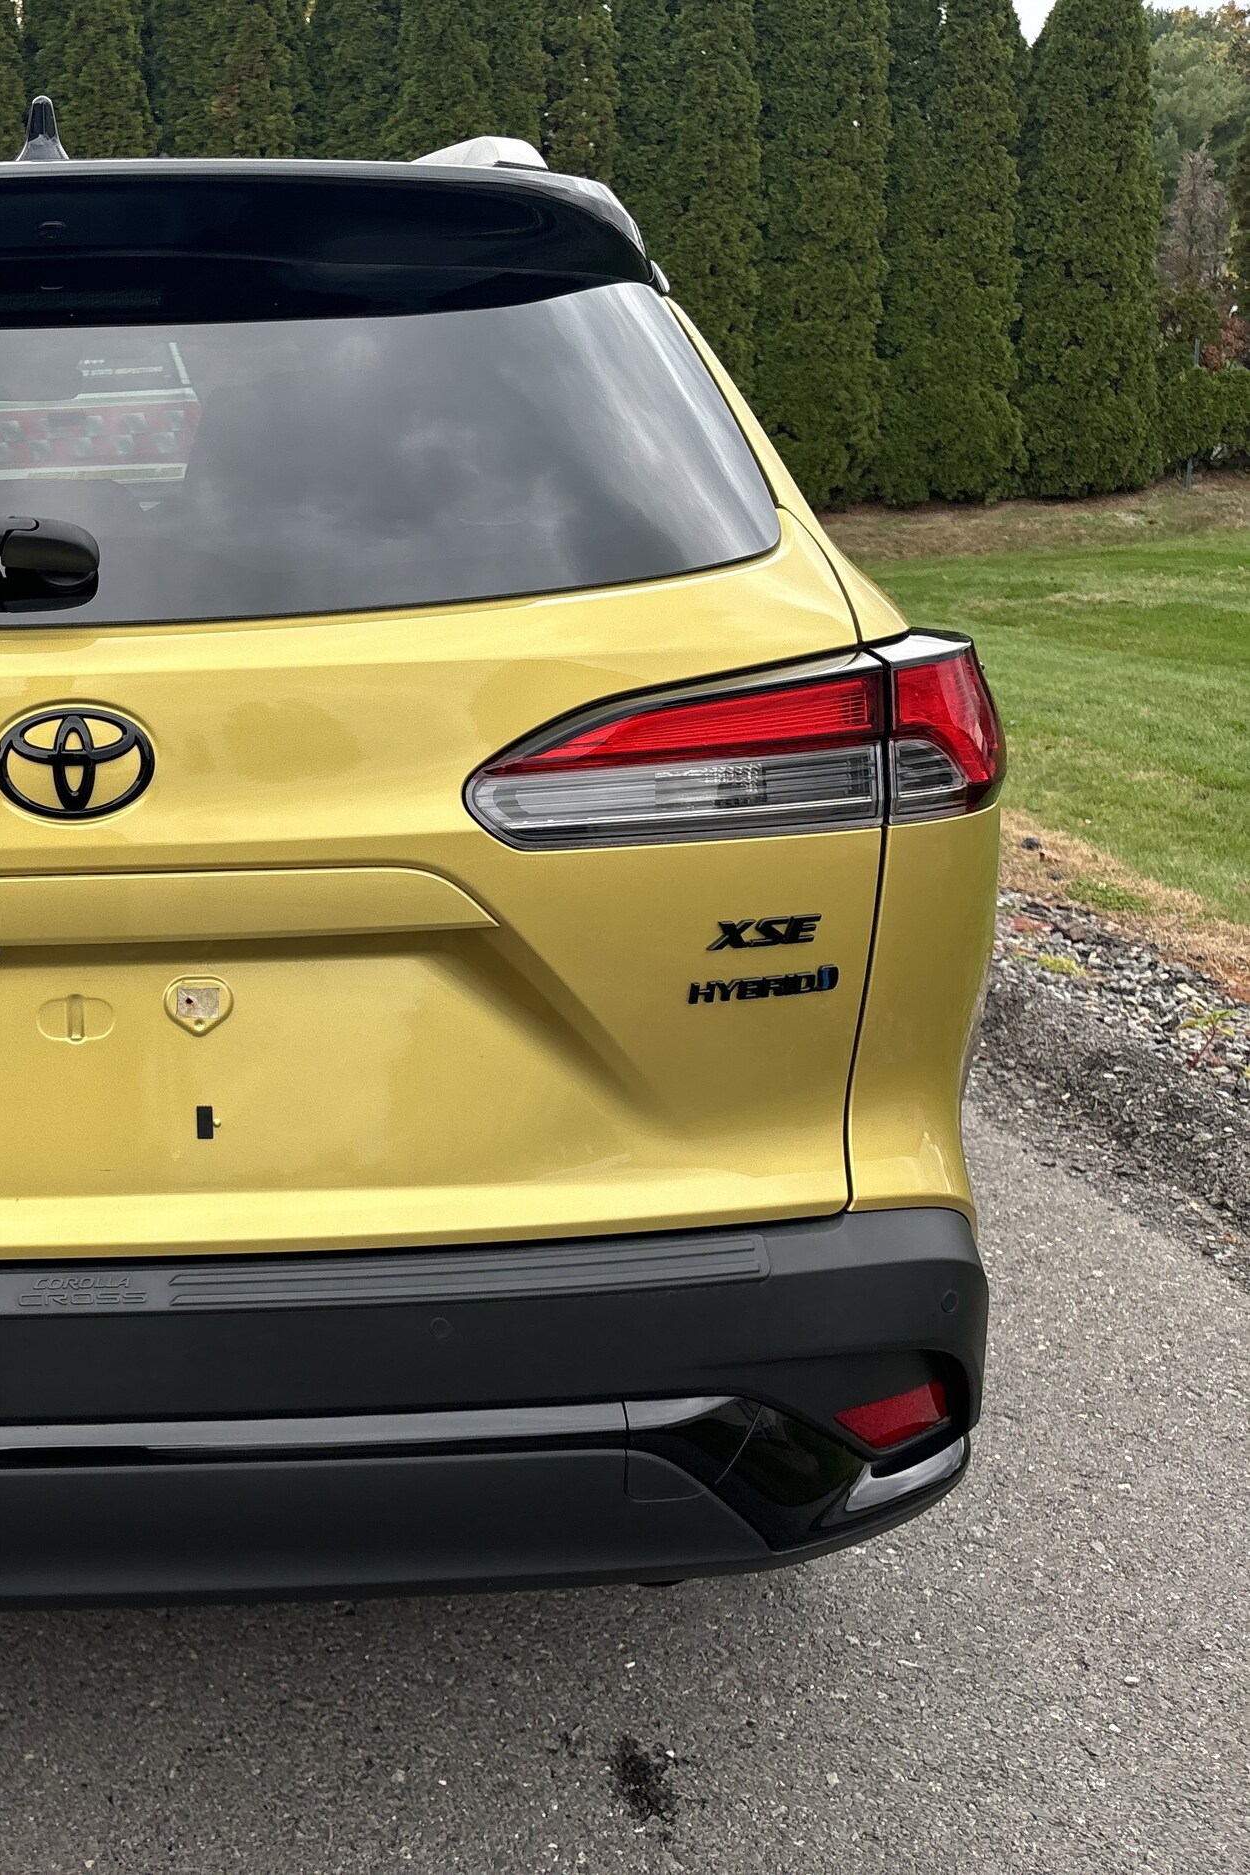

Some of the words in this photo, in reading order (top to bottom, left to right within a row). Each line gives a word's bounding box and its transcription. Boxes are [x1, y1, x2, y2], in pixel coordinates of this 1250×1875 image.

[705, 913, 822, 951] XSE
[688, 971, 817, 1004] HYBRID
[33, 1276, 132, 1290] COROLLA
[18, 1291, 148, 1307] CROSS
